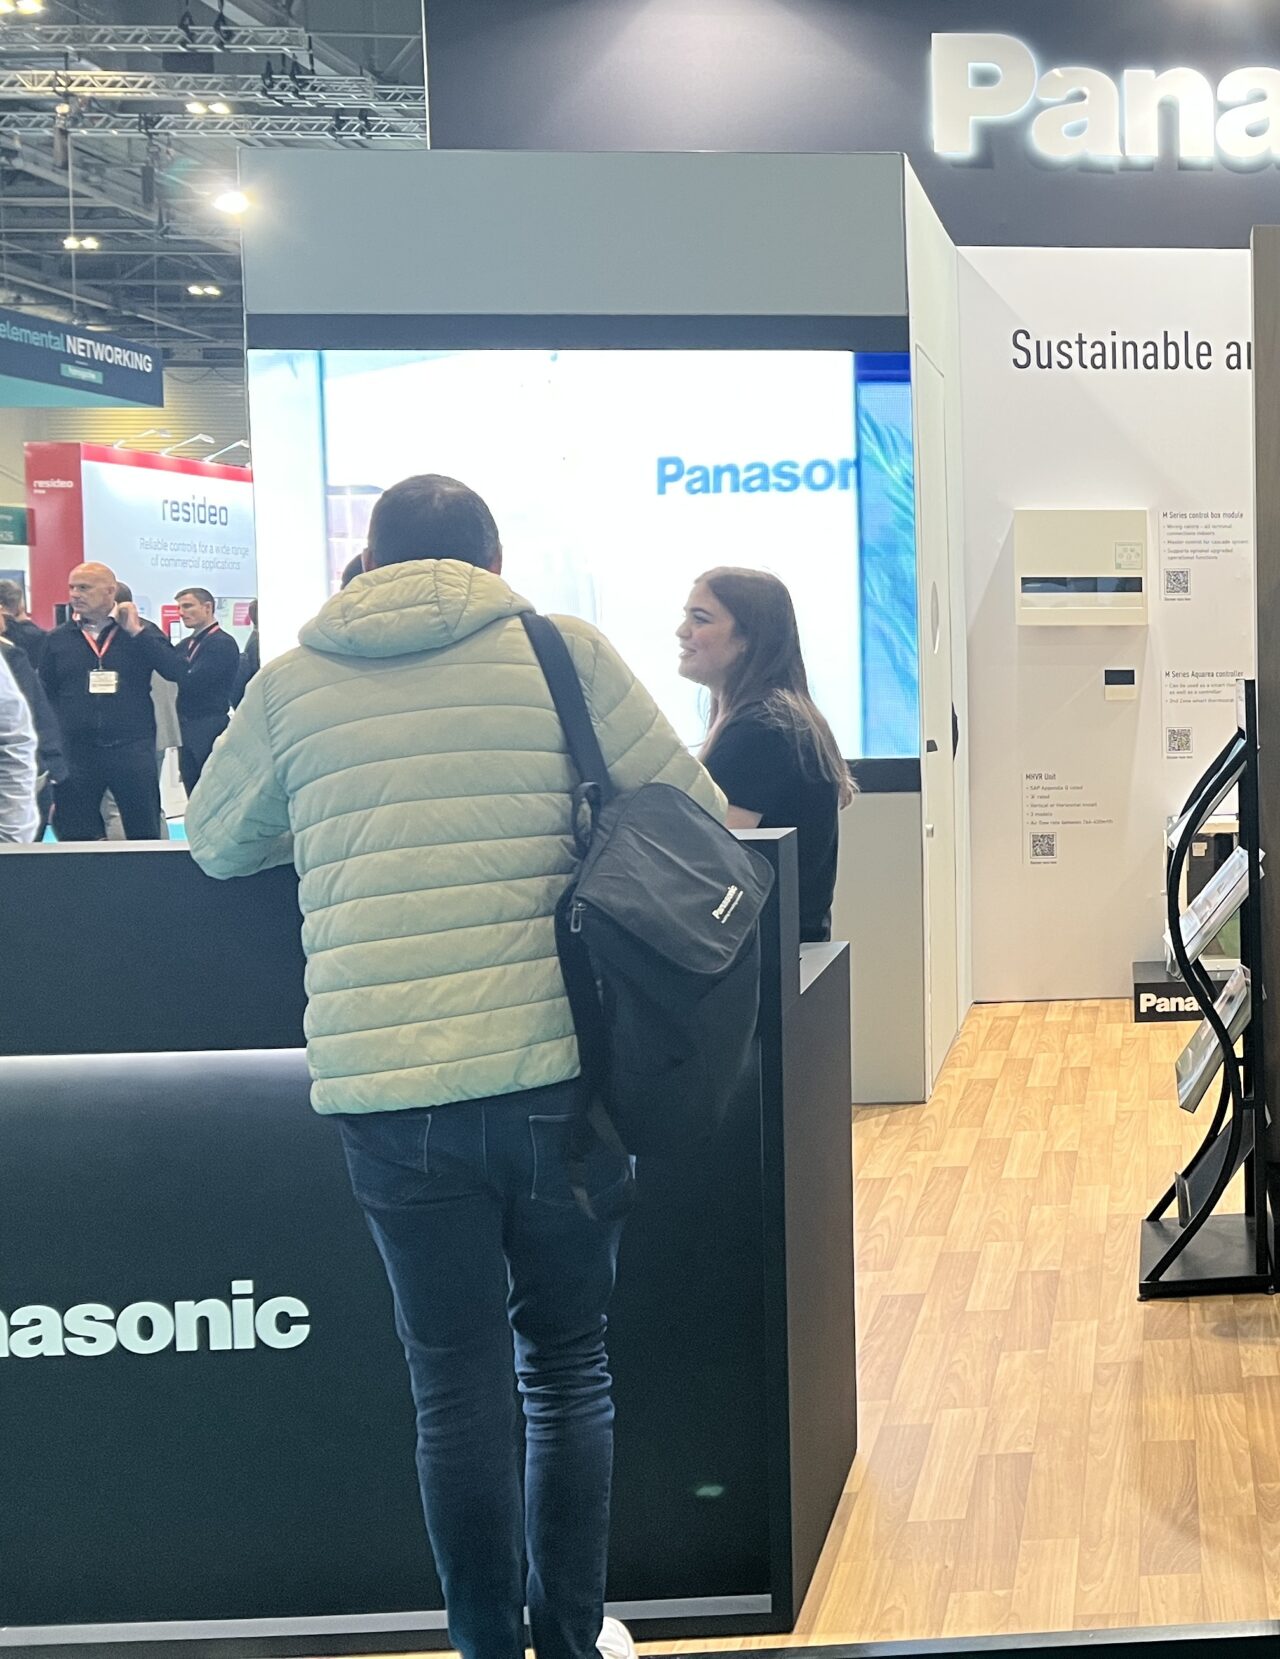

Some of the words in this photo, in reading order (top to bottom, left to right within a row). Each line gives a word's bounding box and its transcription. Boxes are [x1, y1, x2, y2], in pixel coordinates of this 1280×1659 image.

[0, 320, 65, 353] elemental
[65, 334, 153, 373] NETWORKING
[1012, 329, 1212, 370] Sustainable
[33, 478, 74, 489] resideo
[161, 494, 229, 527] resideo
[139, 537, 169, 551] Reliable
[170, 540, 198, 554] controls
[198, 541, 209, 554] for
[214, 542, 231, 556] wide
[231, 545, 249, 559] range
[150, 556, 159, 567] of
[160, 556, 200, 570] commercial
[201, 558, 241, 573] applications
[1140, 993, 1200, 1012] Pana
[0, 1280, 310, 1358] asonic
